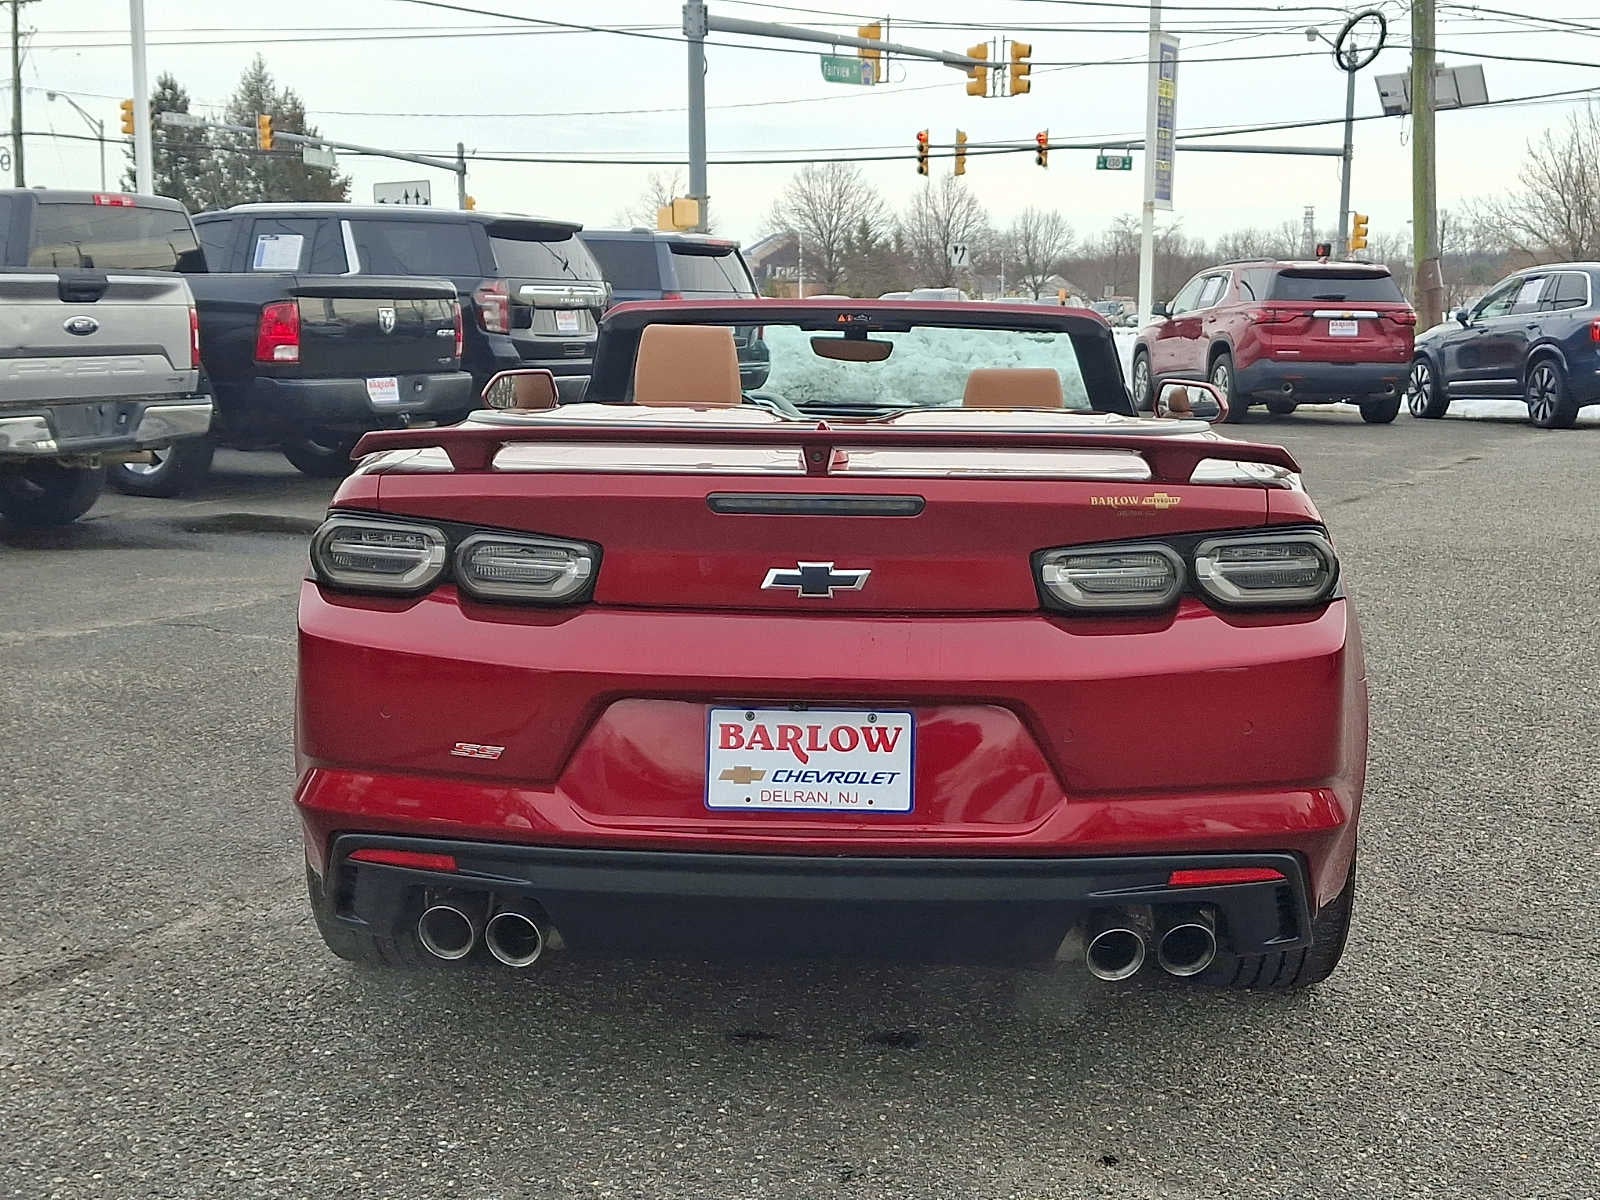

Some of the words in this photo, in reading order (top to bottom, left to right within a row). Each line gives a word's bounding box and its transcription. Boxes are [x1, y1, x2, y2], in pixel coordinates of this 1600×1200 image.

[823, 61, 850, 78] Fairview
[1090, 496, 1139, 508] BARLOW
[450, 742, 505, 760] SS
[718, 723, 902, 764] BARLOW
[772, 769, 900, 785] CHEVROLET
[761, 790, 833, 804] DELRAN,
[838, 792, 859, 804] NJ
